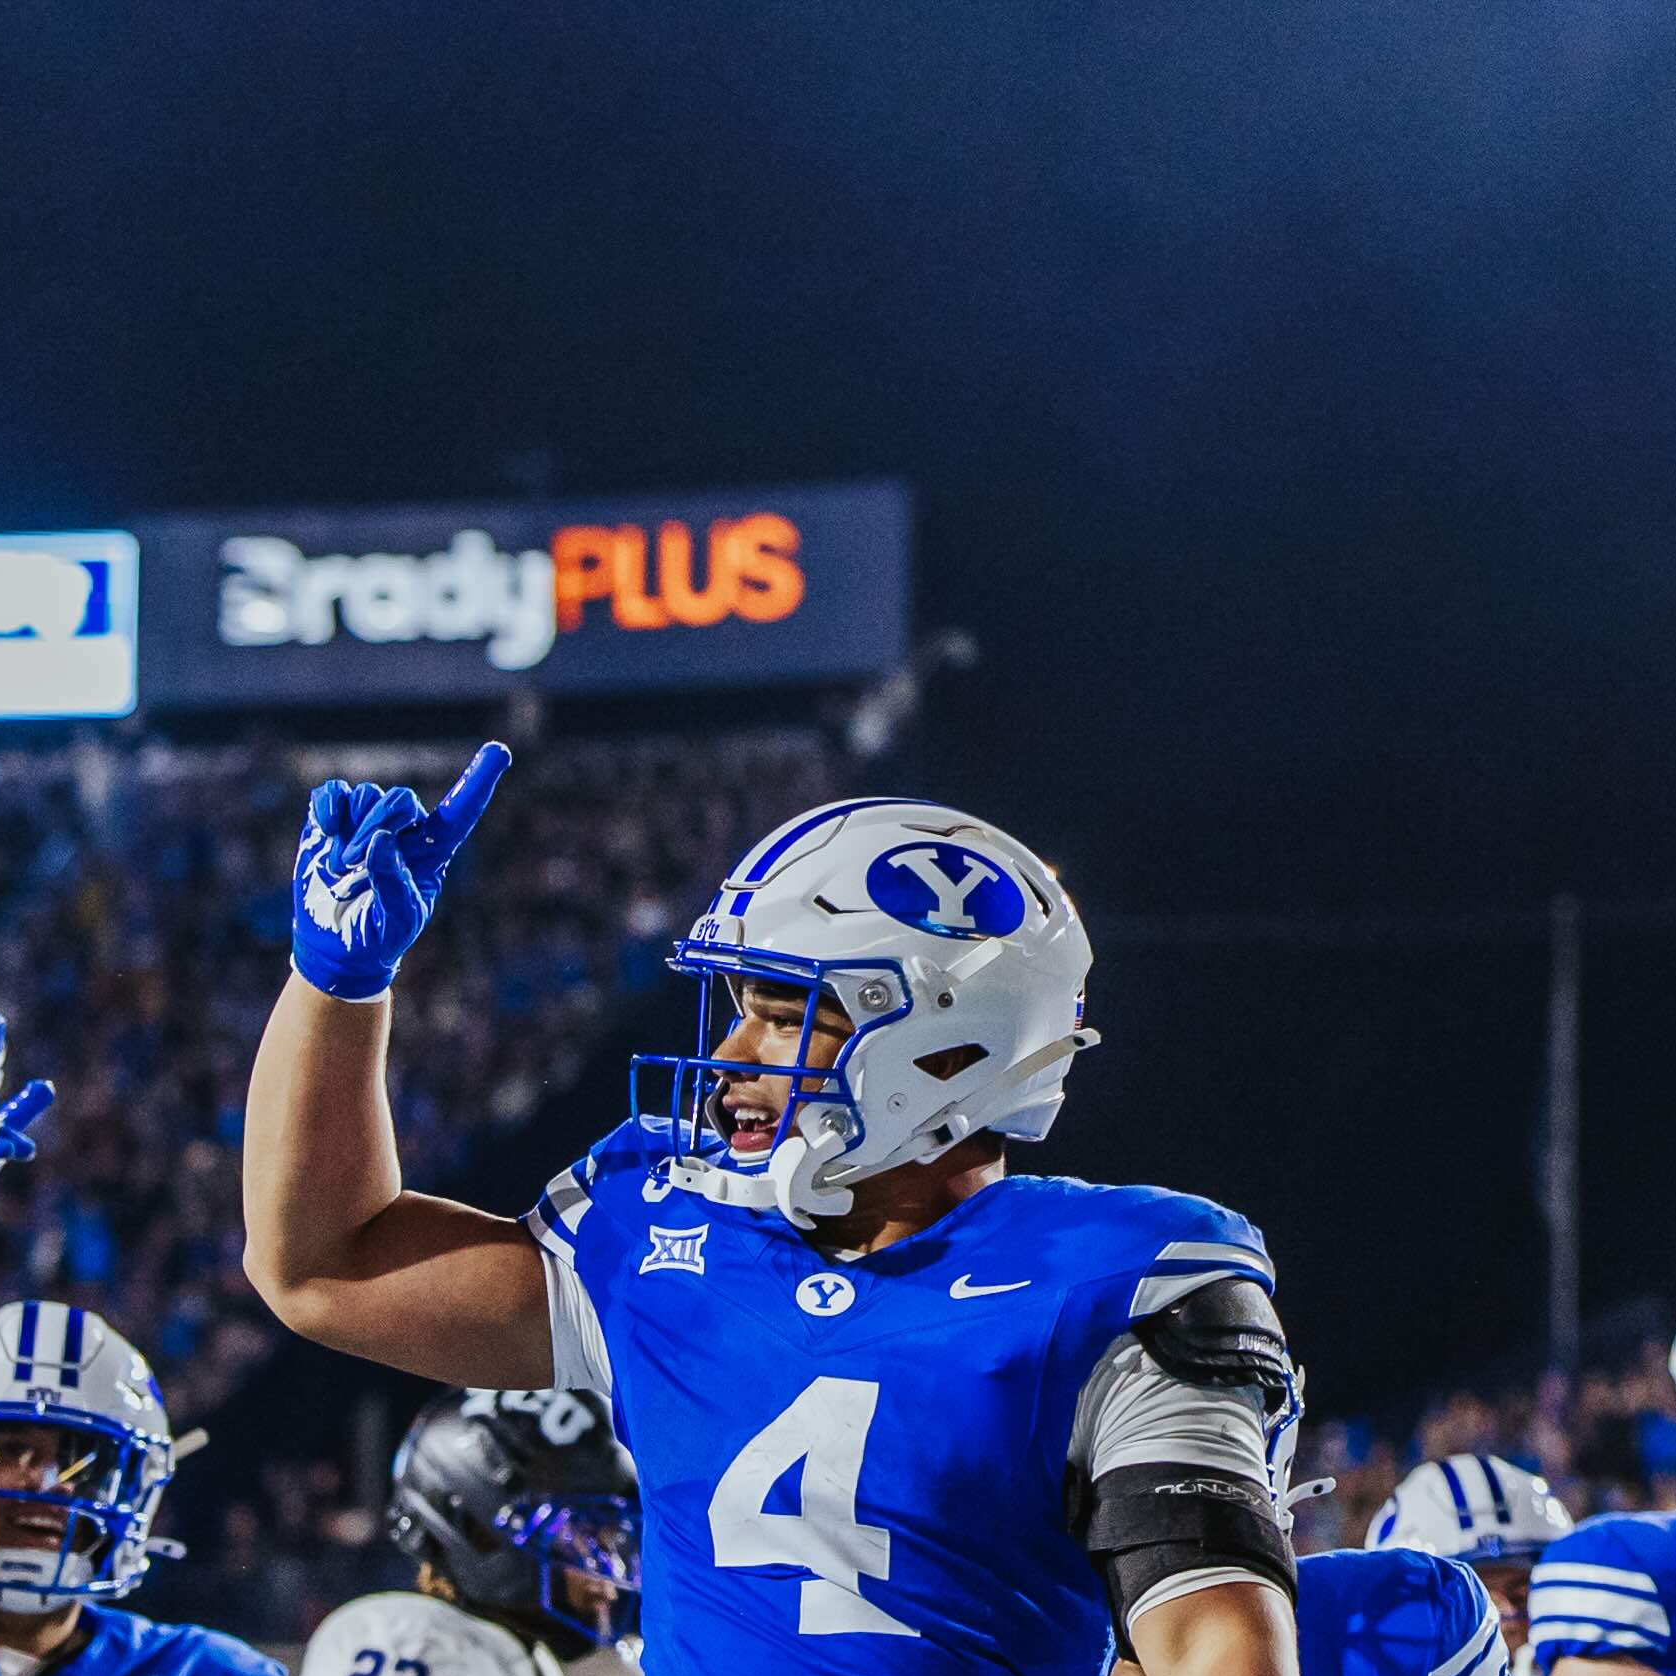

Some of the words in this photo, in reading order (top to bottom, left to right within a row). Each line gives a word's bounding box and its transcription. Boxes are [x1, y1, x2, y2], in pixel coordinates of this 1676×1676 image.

[887, 848, 1000, 929] Y
[696, 918, 721, 941] BYU
[807, 1279, 845, 1309] Y
[708, 1375, 922, 1638] 4
